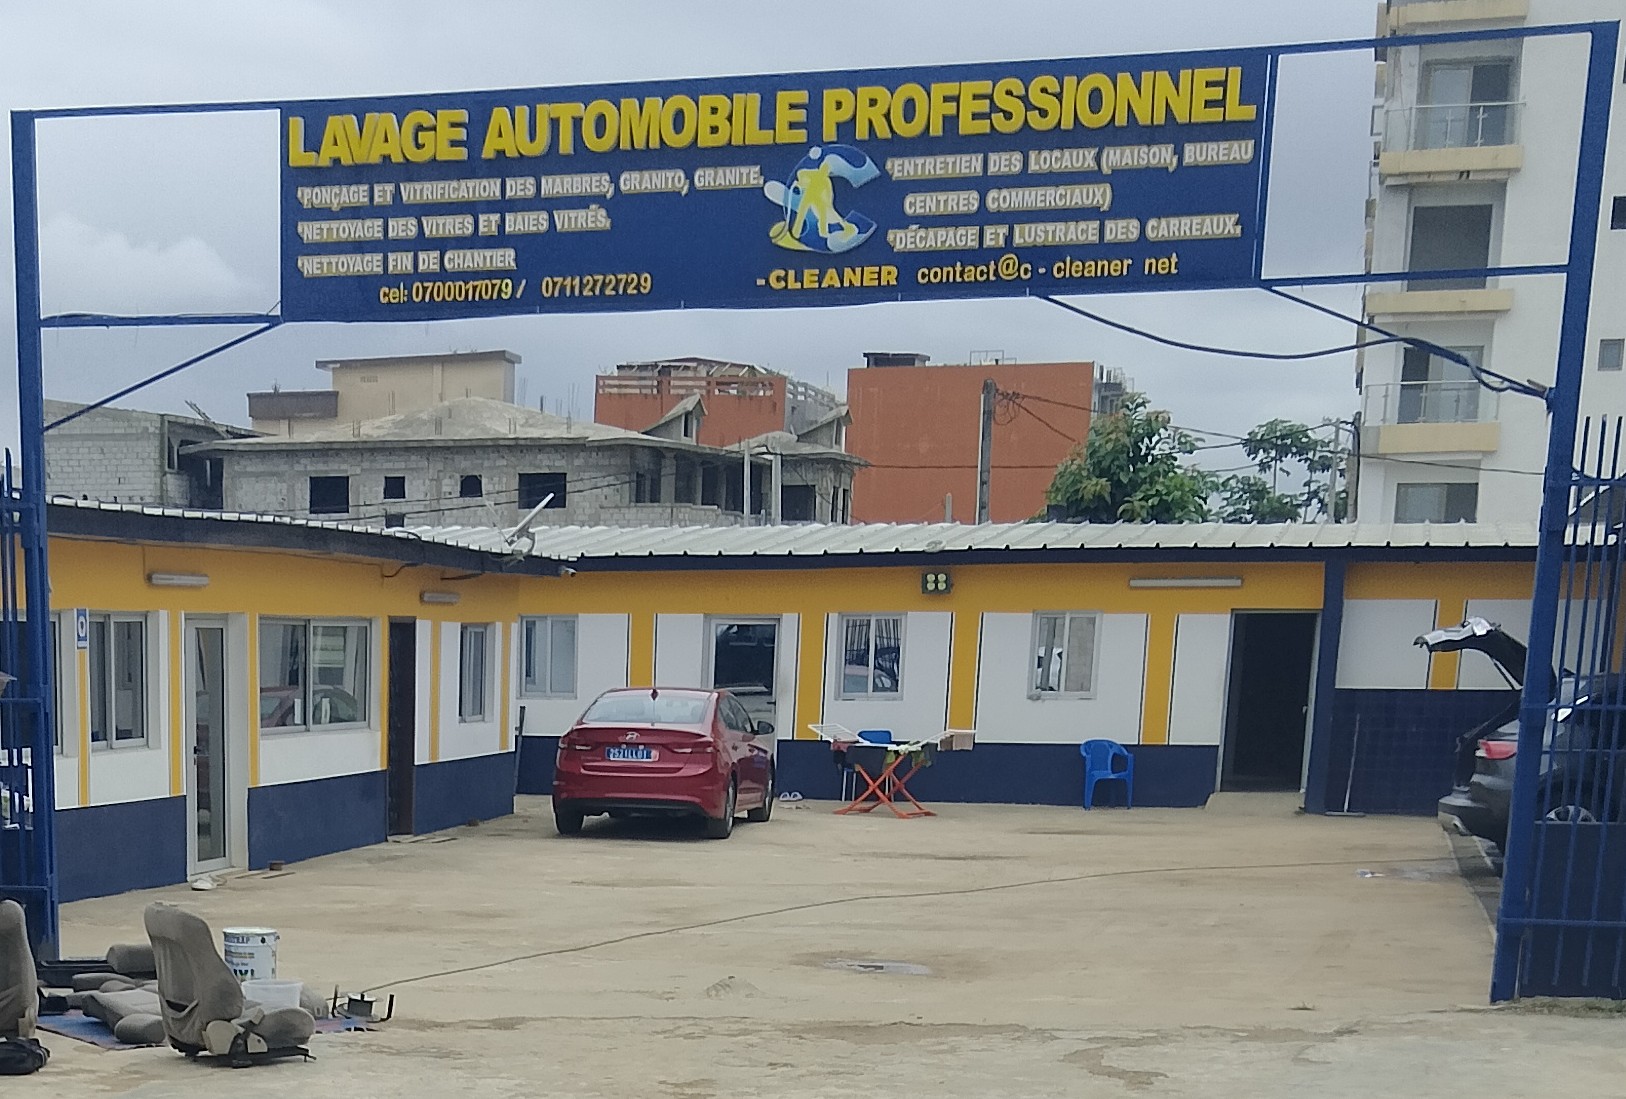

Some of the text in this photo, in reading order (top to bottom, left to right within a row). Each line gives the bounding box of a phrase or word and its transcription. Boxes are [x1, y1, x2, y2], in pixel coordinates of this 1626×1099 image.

[288, 66, 1256, 167] LAVAGE AUTOMOBILE PROFESSIONNEL
[988, 151, 1023, 175] DES
[1028, 148, 1099, 173] LOCAUX
[1101, 144, 1178, 174] (MAISON,
[1183, 140, 1255, 166] BUREAU
[373, 183, 395, 205] ET
[400, 178, 501, 204] VITRIFICATION
[505, 176, 536, 200] DES
[541, 173, 614, 199] MARBRES,
[619, 168, 690, 197] GRANITO,
[904, 183, 1112, 216] CENTRES COMMERCIAUX)
[388, 217, 418, 239] DES
[421, 214, 475, 238] VITRES
[478, 213, 501, 236] ET
[505, 211, 549, 235] BAIES
[983, 225, 1009, 248] ET
[1104, 218, 1140, 243] DES
[388, 251, 414, 274] FIN
[418, 250, 440, 273] DE
[444, 248, 517, 272] CHANTIER
[1144, 252, 1178, 275] net
[412, 279, 512, 303] 0700017079
[541, 273, 652, 298] 0711272729
